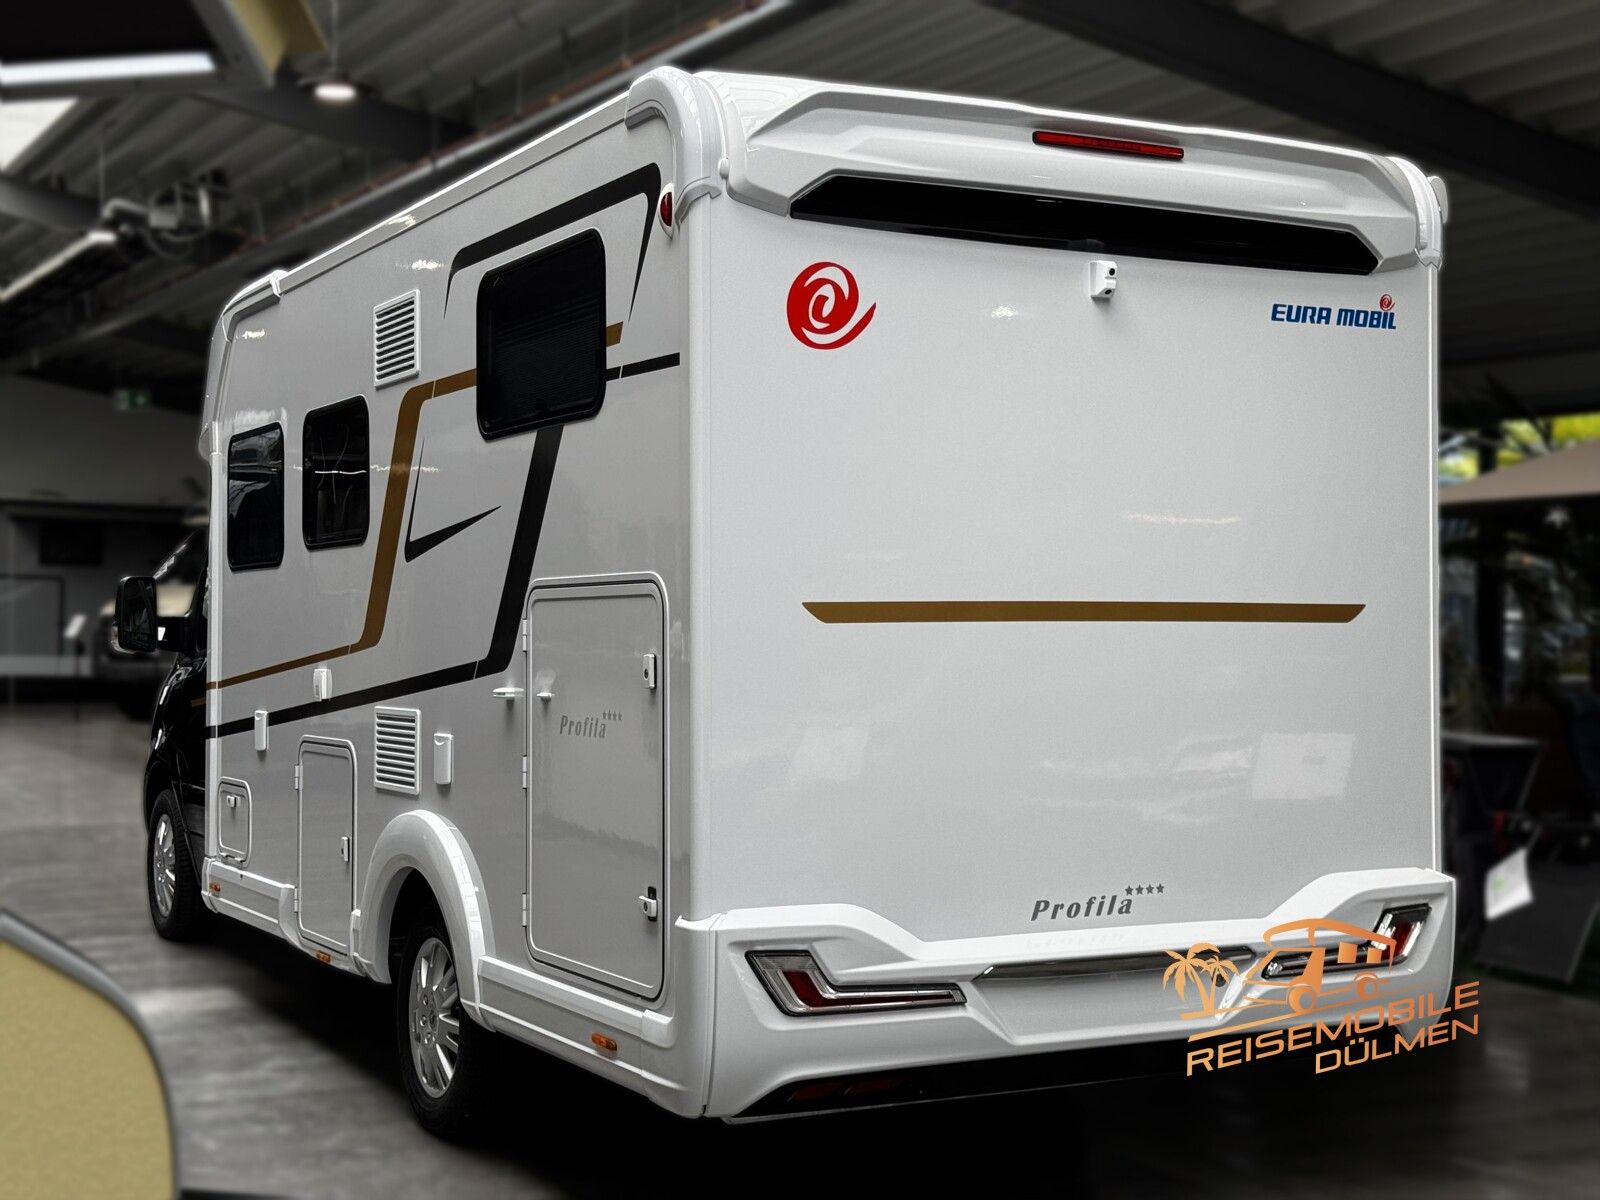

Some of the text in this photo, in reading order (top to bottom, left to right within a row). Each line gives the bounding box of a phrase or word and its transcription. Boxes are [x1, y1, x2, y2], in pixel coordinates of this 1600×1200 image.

[1271, 303, 1397, 330] EURA MOBIL
[560, 715, 606, 738] Profila
[1031, 895, 1133, 921] Profila
